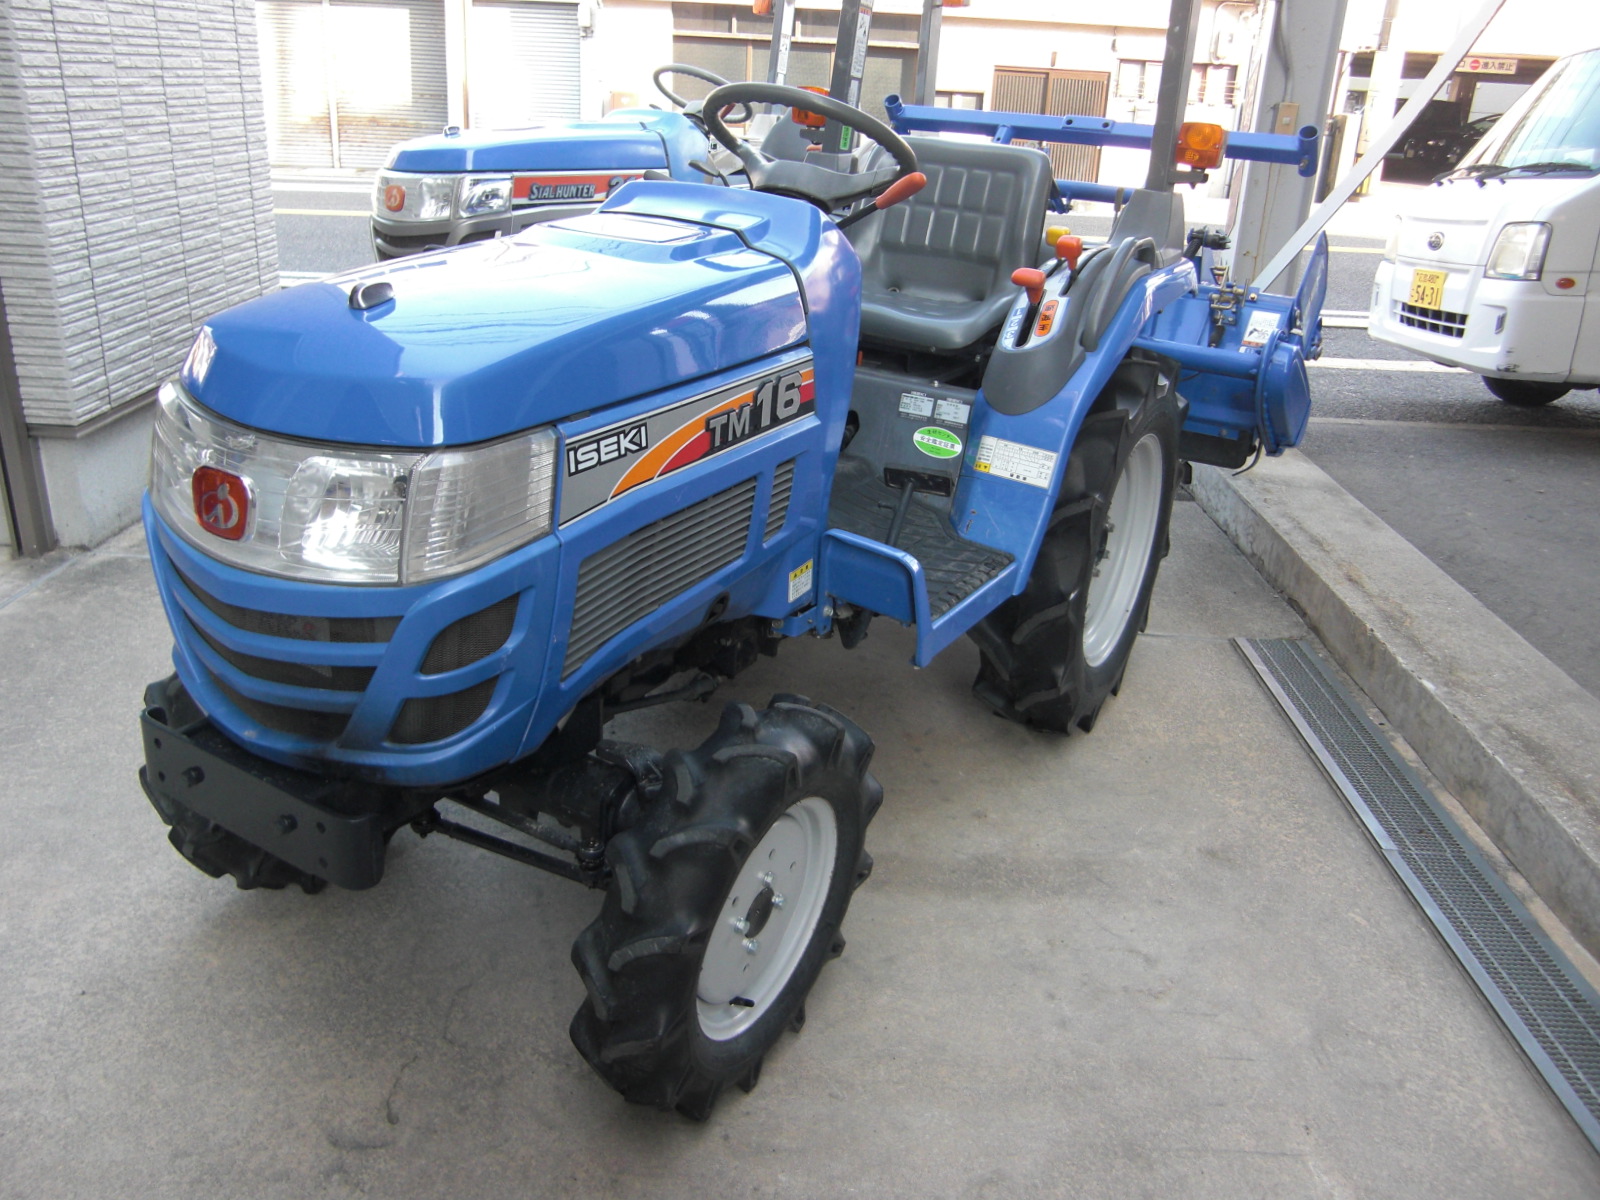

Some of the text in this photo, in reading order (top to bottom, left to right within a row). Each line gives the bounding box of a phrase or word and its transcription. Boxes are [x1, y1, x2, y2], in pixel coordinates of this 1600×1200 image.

[1481, 61, 1513, 71] 進入禁止
[568, 424, 647, 474] ISEKI
